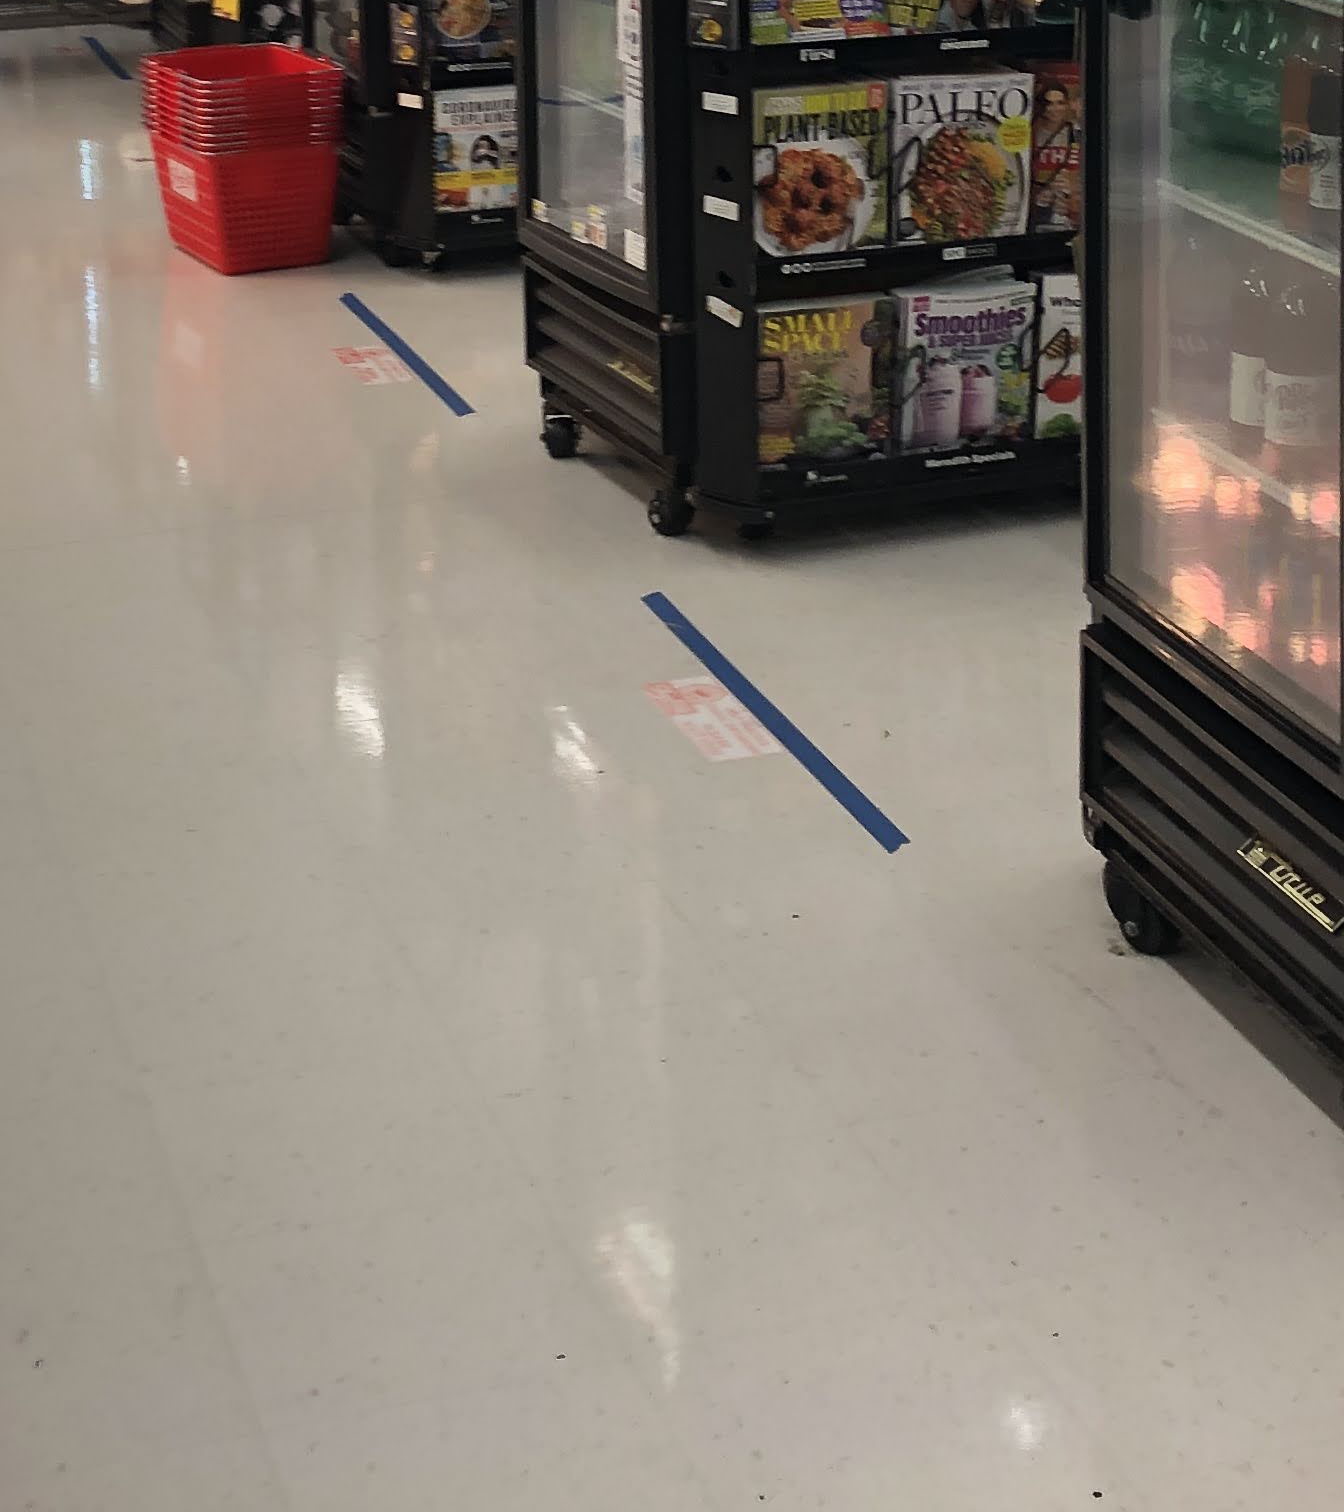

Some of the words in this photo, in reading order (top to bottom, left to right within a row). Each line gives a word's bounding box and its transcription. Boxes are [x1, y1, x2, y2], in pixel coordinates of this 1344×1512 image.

[900, 88, 1029, 125] PALEO
[764, 111, 880, 143] PLANT-BASED
[915, 306, 1026, 337] Smoothies
